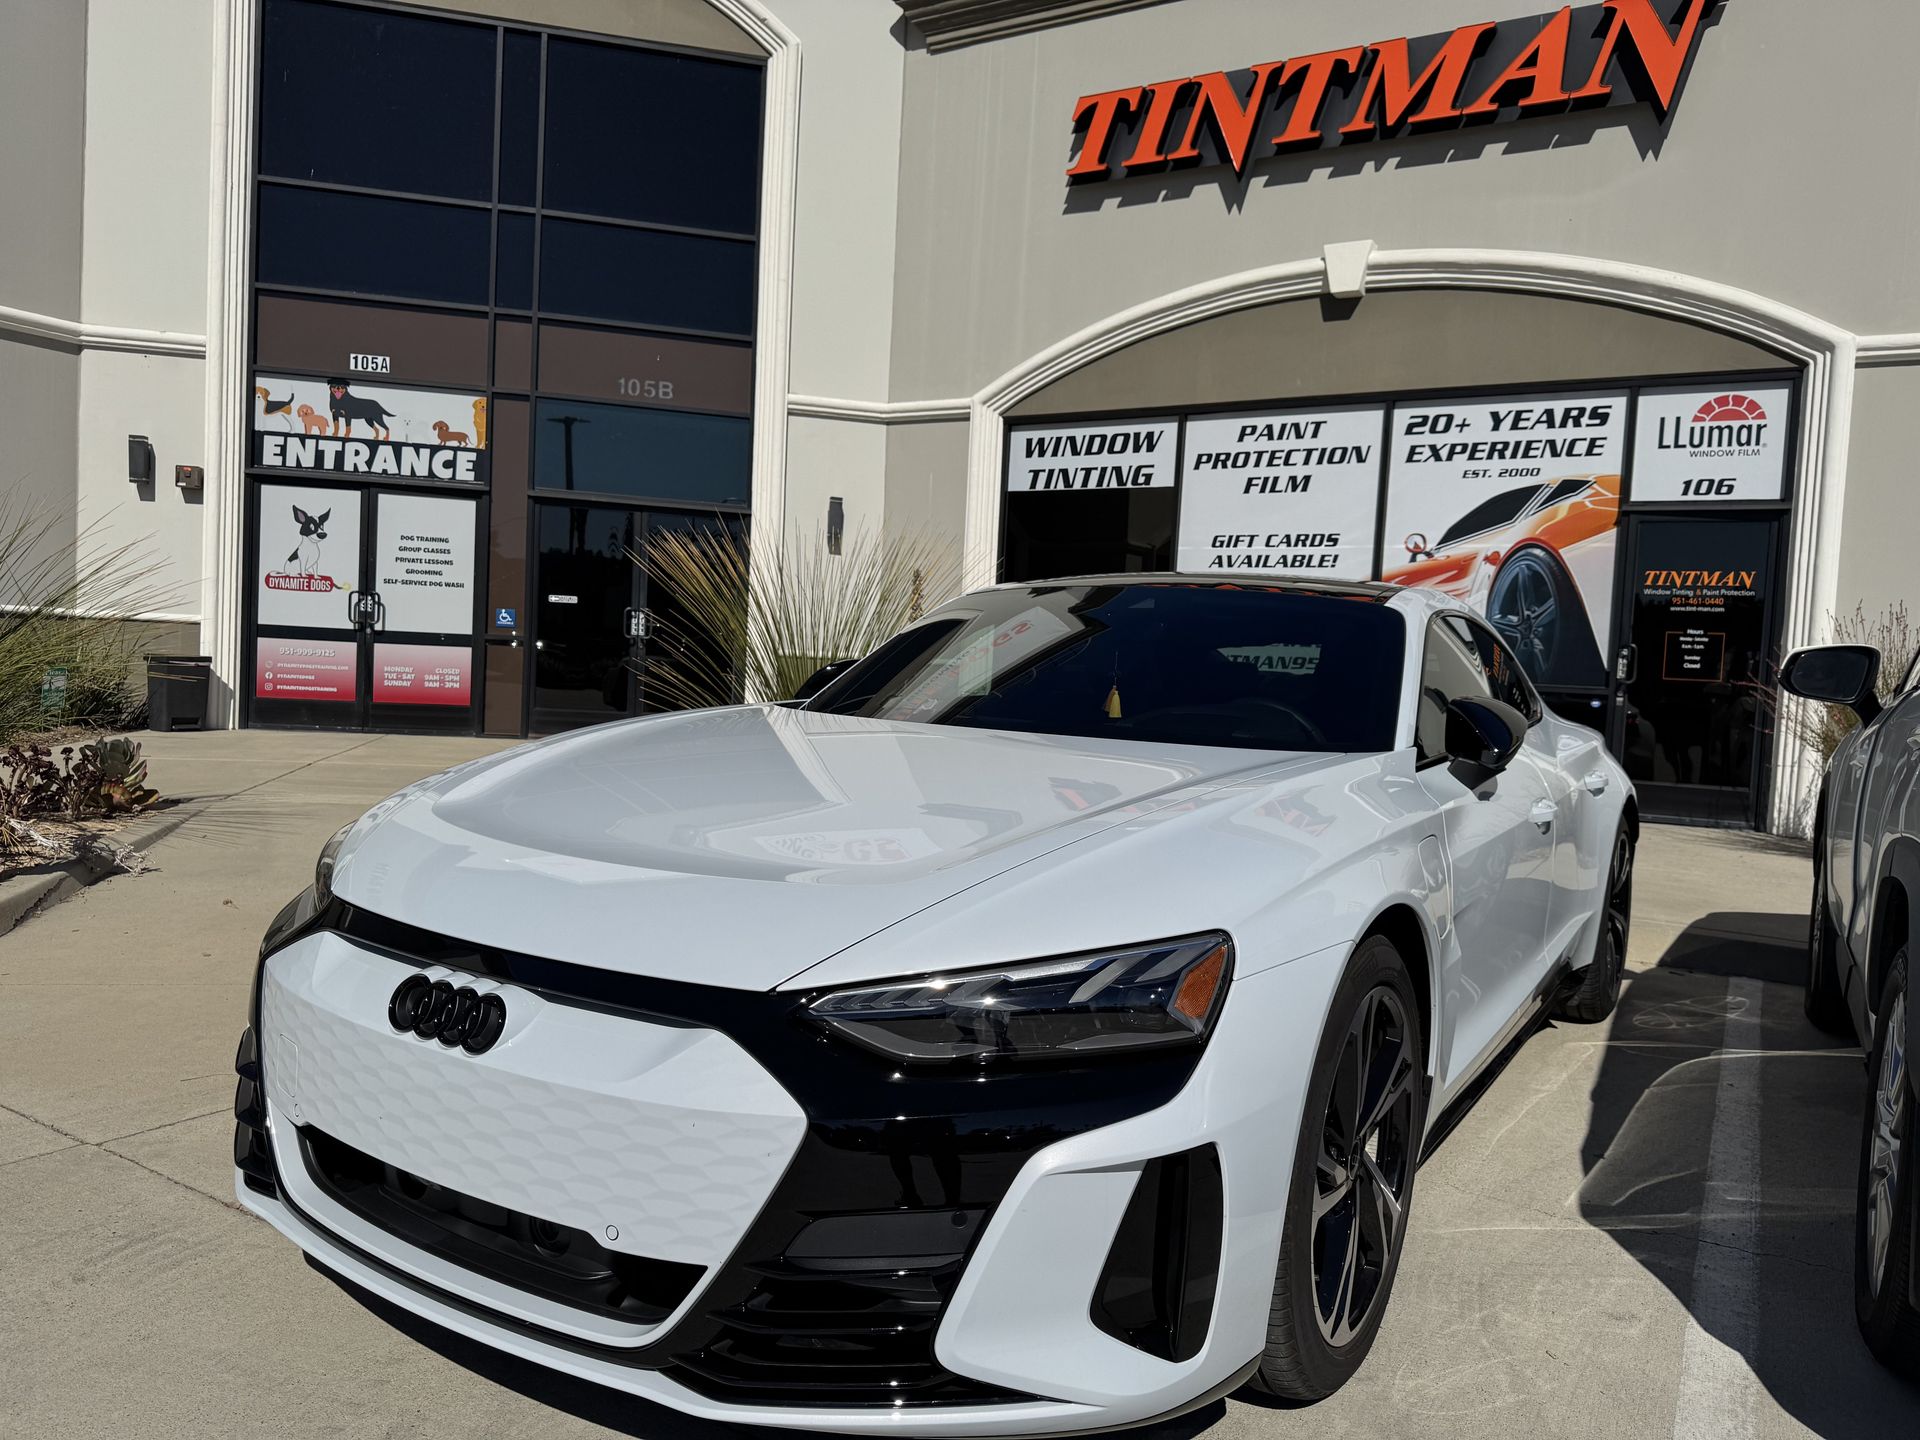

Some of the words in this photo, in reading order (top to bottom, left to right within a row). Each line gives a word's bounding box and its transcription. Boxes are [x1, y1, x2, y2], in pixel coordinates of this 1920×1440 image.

[1066, 0, 1706, 176] TINTMAN
[352, 355, 389, 372] 105A
[618, 377, 673, 399] 105B
[1404, 413, 1471, 436] 20+
[1489, 405, 1612, 432] YEARS
[1236, 420, 1327, 443] PAINT
[1657, 416, 1767, 449] LLumar
[1025, 430, 1164, 458] WINDOW
[1404, 436, 1607, 463] EXPERIENCE
[262, 435, 477, 481] ENTRANCE
[1193, 445, 1371, 470] PROTECTION
[1689, 449, 1735, 458] WINDOW
[1737, 448, 1760, 457] FILM
[1027, 464, 1155, 490] TINTING
[1462, 469, 1492, 479] EST.
[1498, 467, 1541, 478] 2000
[1242, 474, 1312, 494] FILM
[1681, 478, 1737, 496] 106
[416, 536, 450, 544] TRAINING
[1211, 533, 1259, 549] GIFT
[1264, 532, 1340, 548] CARDS
[423, 547, 451, 555] CLASSES
[395, 556, 423, 564] PRIVATE
[424, 558, 454, 566] LESSONS
[1208, 553, 1339, 569] AVAILABLE!
[405, 568, 443, 576] GROOMING
[1644, 570, 1756, 589] TINTMAN
[269, 577, 309, 590] DYNAMITE
[310, 579, 331, 591] DOGS
[383, 578, 428, 586] SELF-SERVICE
[1672, 588, 1694, 596] Tinting
[1671, 597, 1724, 605] 951-461-0440
[435, 667, 460, 675] CLOSED
[384, 679, 412, 687] SUNDAY
